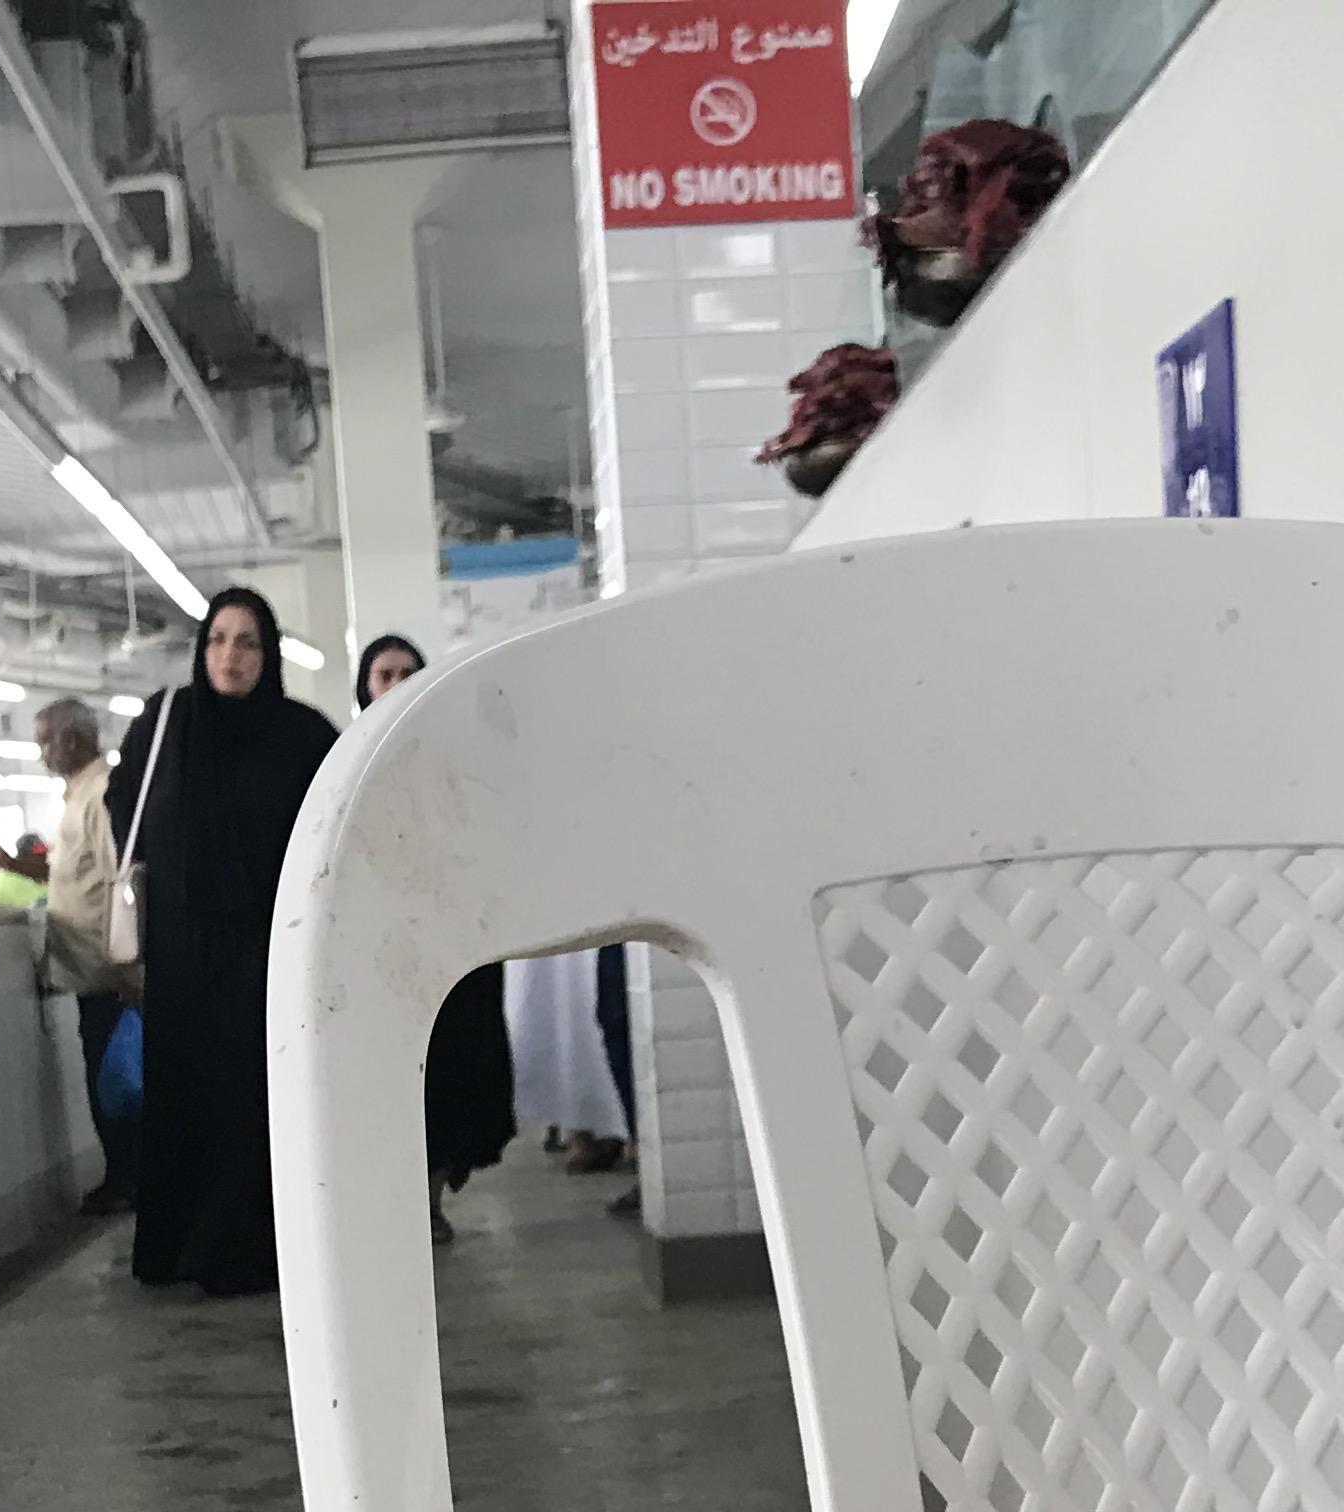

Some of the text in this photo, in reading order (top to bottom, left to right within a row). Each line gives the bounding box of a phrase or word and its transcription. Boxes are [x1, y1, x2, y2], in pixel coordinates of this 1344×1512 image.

[601, 18, 834, 68] ممنوع التدخين
[609, 160, 845, 210] NO SMOKING
